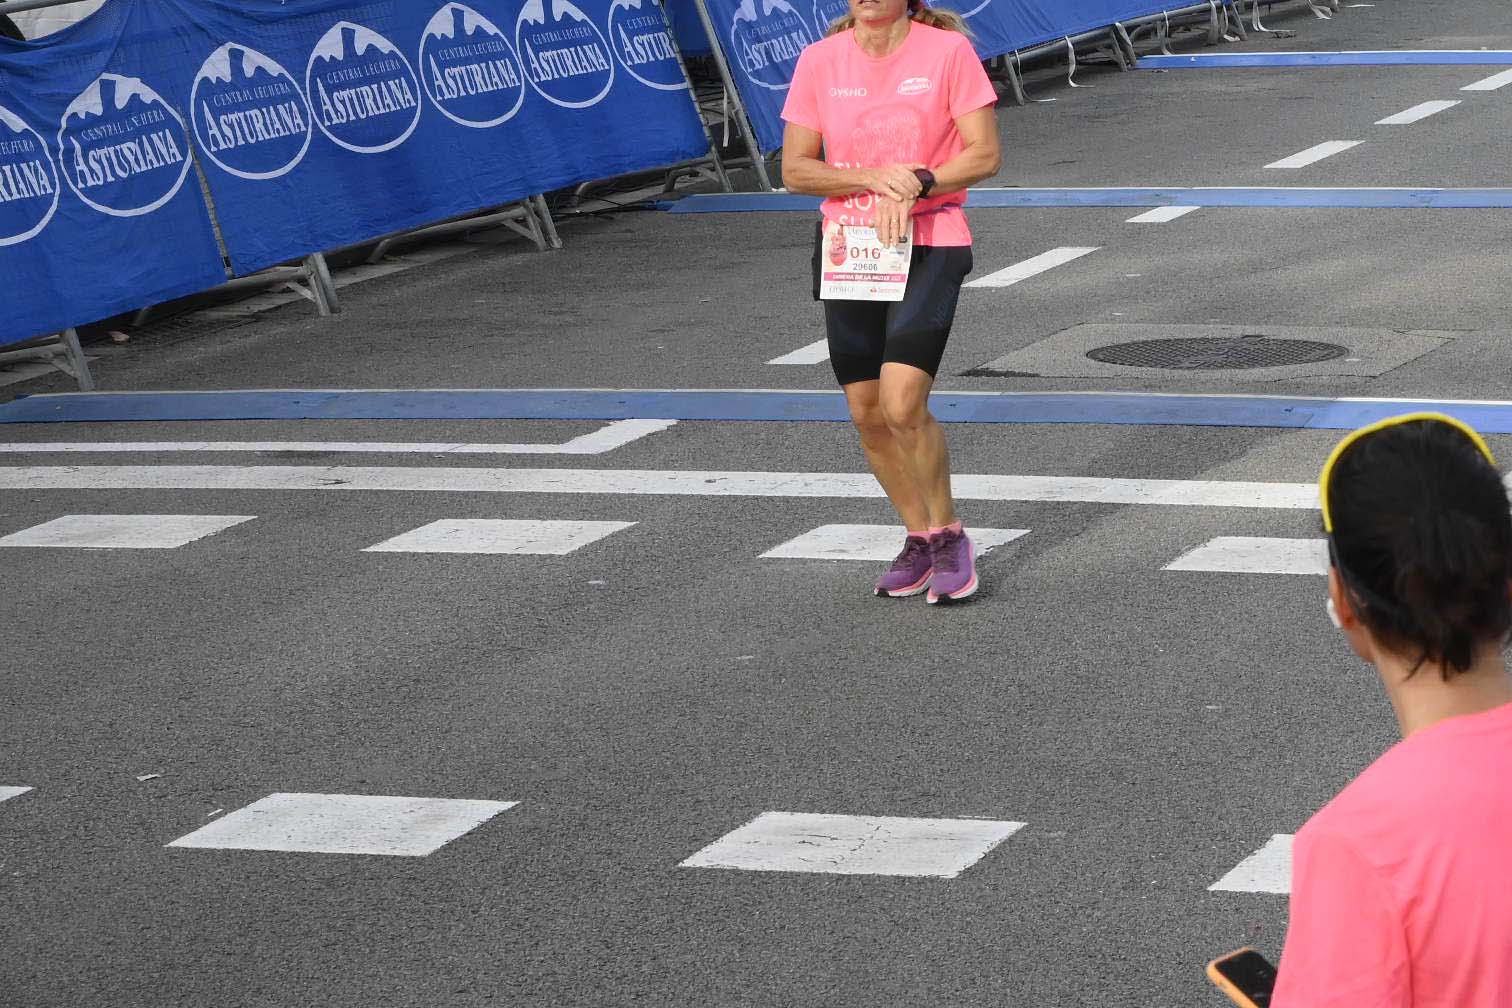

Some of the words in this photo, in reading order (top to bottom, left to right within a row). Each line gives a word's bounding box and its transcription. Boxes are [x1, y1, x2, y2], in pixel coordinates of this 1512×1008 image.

[532, 31, 562, 45] CENTRAL
[563, 26, 593, 42] LECHERA
[438, 46, 471, 61] CENTRAL
[473, 39, 505, 56] LECHERA
[524, 38, 609, 83] ASTURIANA
[326, 67, 363, 85] CENTRAL
[365, 58, 401, 75] LECHERA
[429, 53, 521, 102] ASTURIANA
[213, 90, 252, 108] CENTRAL
[253, 81, 290, 99] LECHERA
[316, 77, 416, 128] ASTURIANA
[829, 87, 867, 97] OYSHO
[81, 124, 125, 143] CENTRAL
[202, 98, 306, 153] ASTURIANA
[0, 140, 35, 156] ECHERA
[0, 159, 53, 202] RIANA
[850, 247, 881, 260] 016
